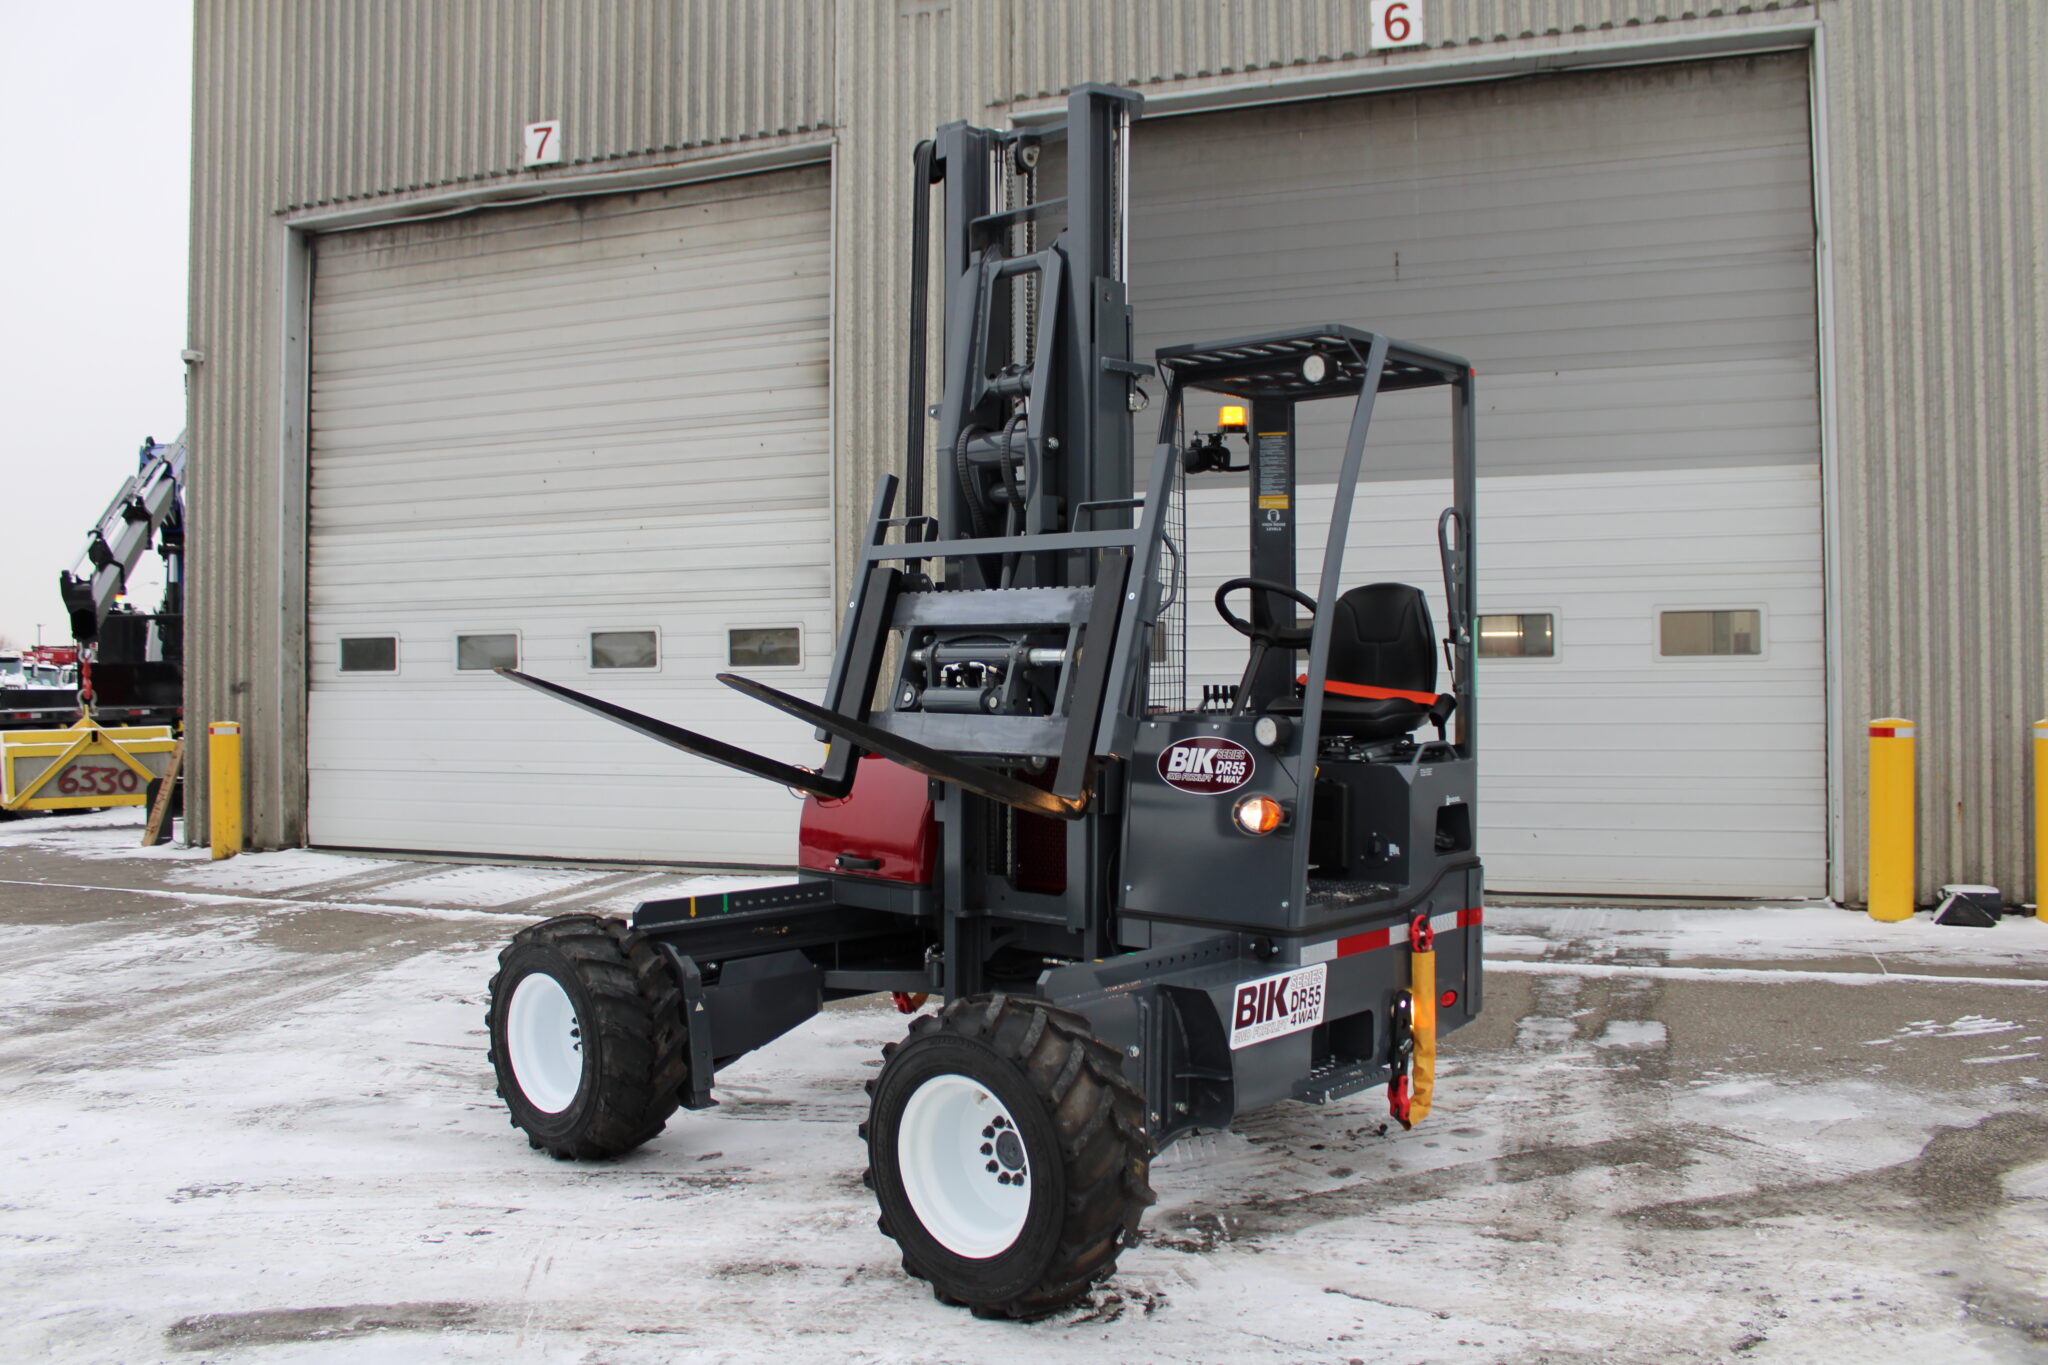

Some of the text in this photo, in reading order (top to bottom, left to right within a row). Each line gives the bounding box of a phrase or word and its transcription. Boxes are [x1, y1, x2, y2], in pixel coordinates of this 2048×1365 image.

[1385, 2, 1411, 42] 6
[533, 126, 553, 160] 7
[1168, 747, 1217, 774] BIK
[1217, 749, 1245, 760] SERIES
[58, 765, 138, 794] 6330
[1216, 761, 1246, 775] DR55
[1216, 775, 1222, 783] 4
[1290, 968, 1324, 990] SERIES
[1235, 976, 1291, 1031] BIK
[1291, 986, 1321, 1012] DR55
[1290, 1013, 1297, 1026] 4
